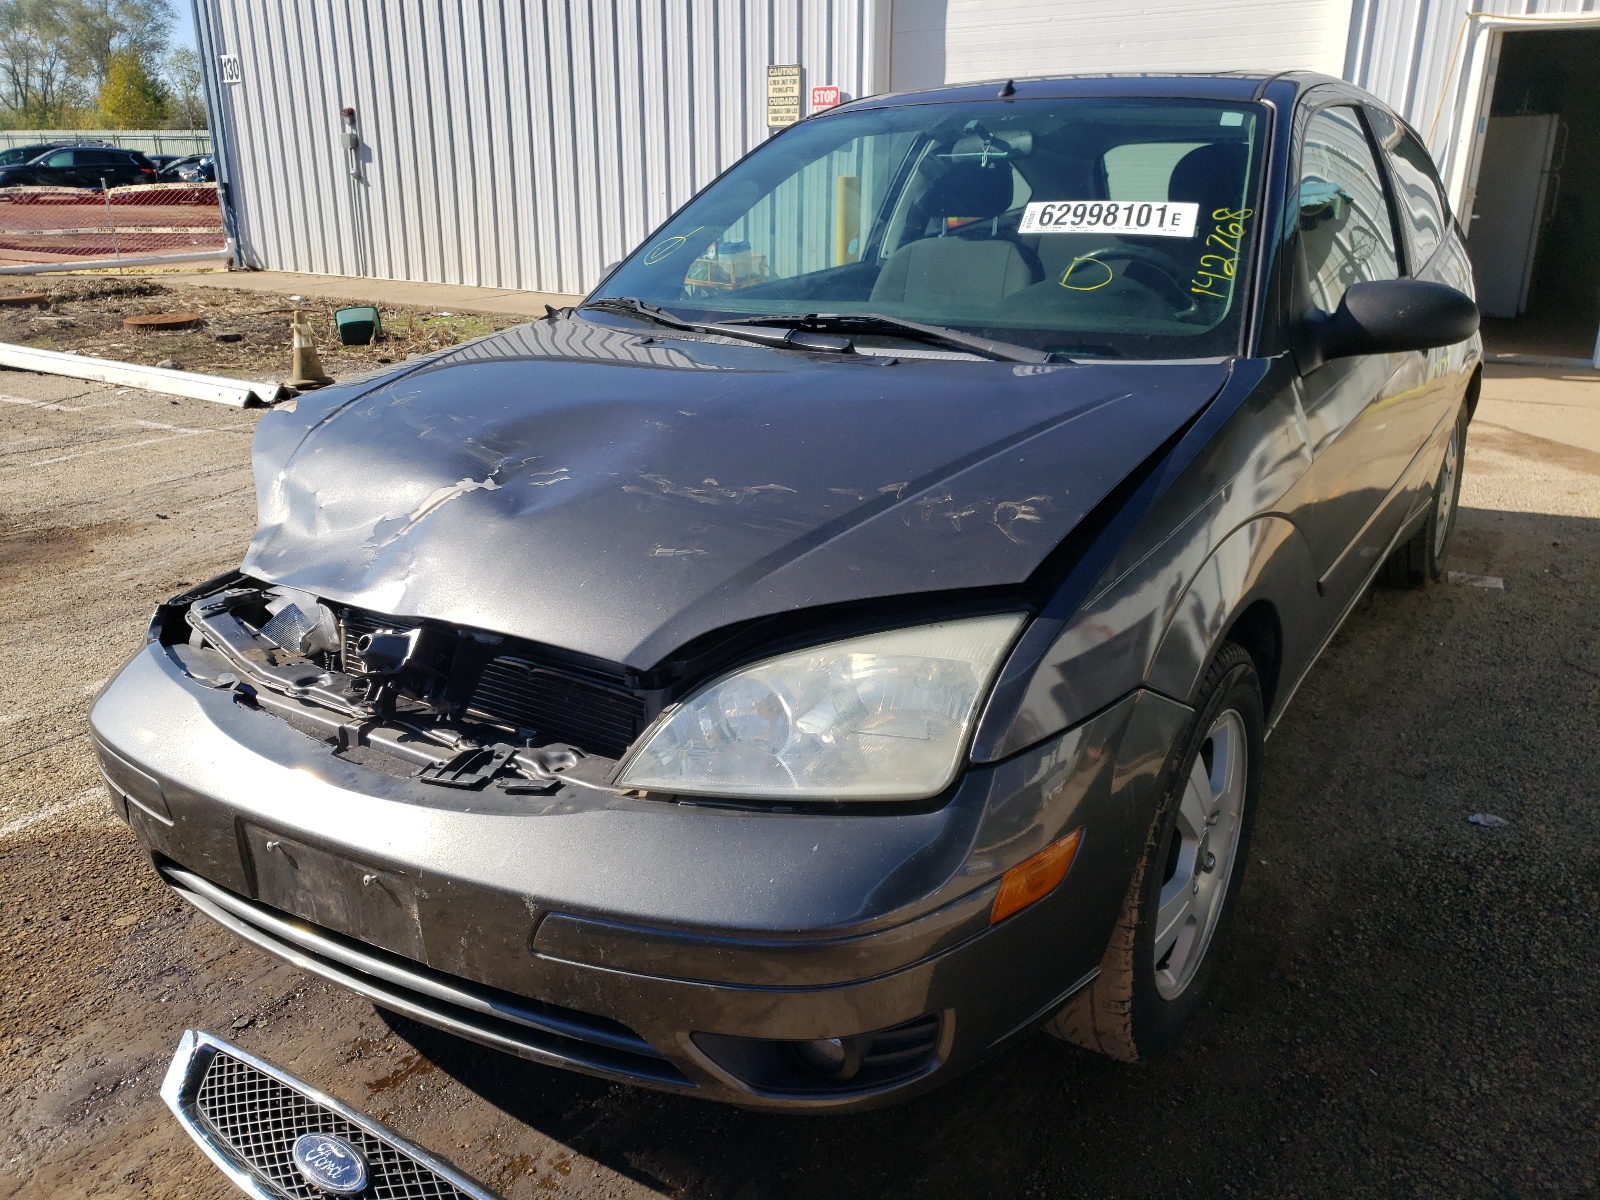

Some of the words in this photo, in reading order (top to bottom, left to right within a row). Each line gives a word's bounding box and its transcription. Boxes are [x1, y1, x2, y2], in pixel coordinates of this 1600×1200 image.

[223, 57, 240, 81] 130
[768, 67, 798, 76] CAUTION
[772, 86, 794, 94] FORKLIFTS
[814, 90, 837, 103] STOP
[768, 96, 798, 106] CUIDADO
[1038, 203, 1168, 228] 62998101
[1171, 212, 1182, 226] E
[1191, 207, 1254, 299] 142768
[305, 1142, 350, 1179] Ford
